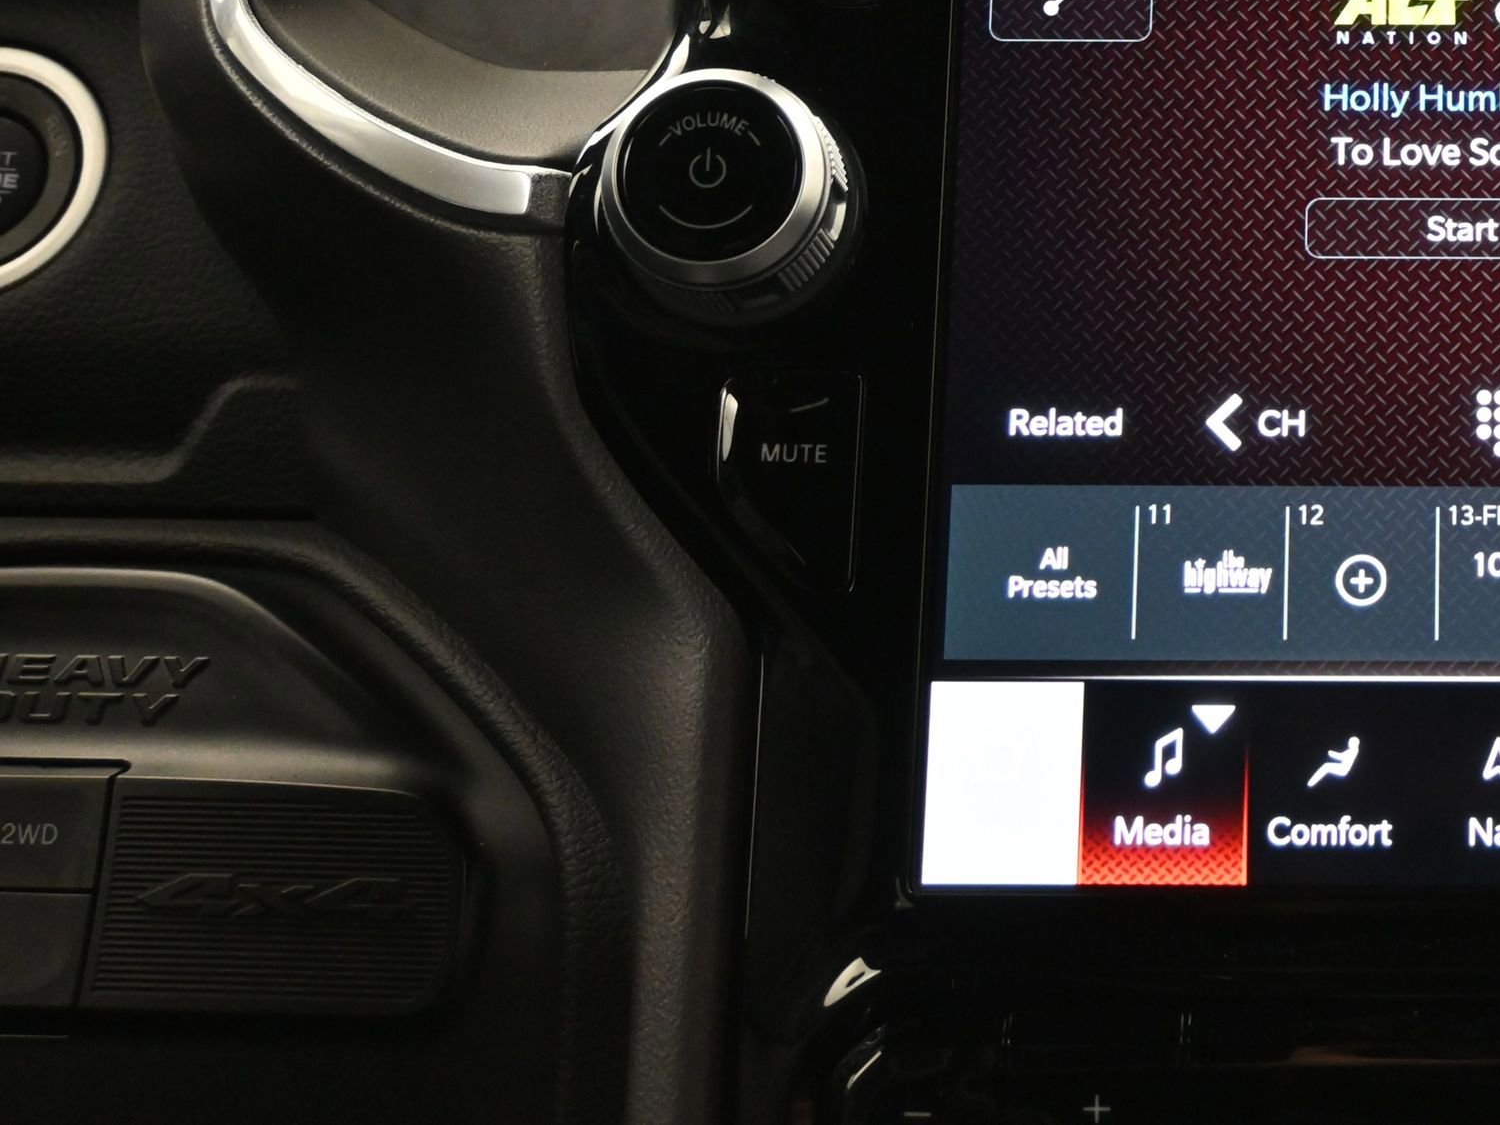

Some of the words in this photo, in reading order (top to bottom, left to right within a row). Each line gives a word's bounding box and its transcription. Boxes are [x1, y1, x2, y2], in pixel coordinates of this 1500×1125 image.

[1335, 31, 1468, 45] NATION
[1323, 82, 1410, 118] Holly
[669, 112, 749, 136] VOLUME
[1331, 136, 1375, 167] To
[1382, 136, 1461, 167] Love
[1426, 215, 1498, 243] Start
[1008, 407, 1123, 438] Related
[1257, 410, 1306, 437] CH
[760, 442, 827, 464] MUTE
[1148, 503, 1171, 525] 11
[1298, 503, 1324, 526] 12
[1039, 546, 1070, 570] All
[1006, 574, 1098, 600] Presets
[1184, 561, 1272, 594] highway
[1, 823, 58, 845] 2WD
[1112, 814, 1211, 848] Media
[1266, 814, 1393, 848] Comfort
